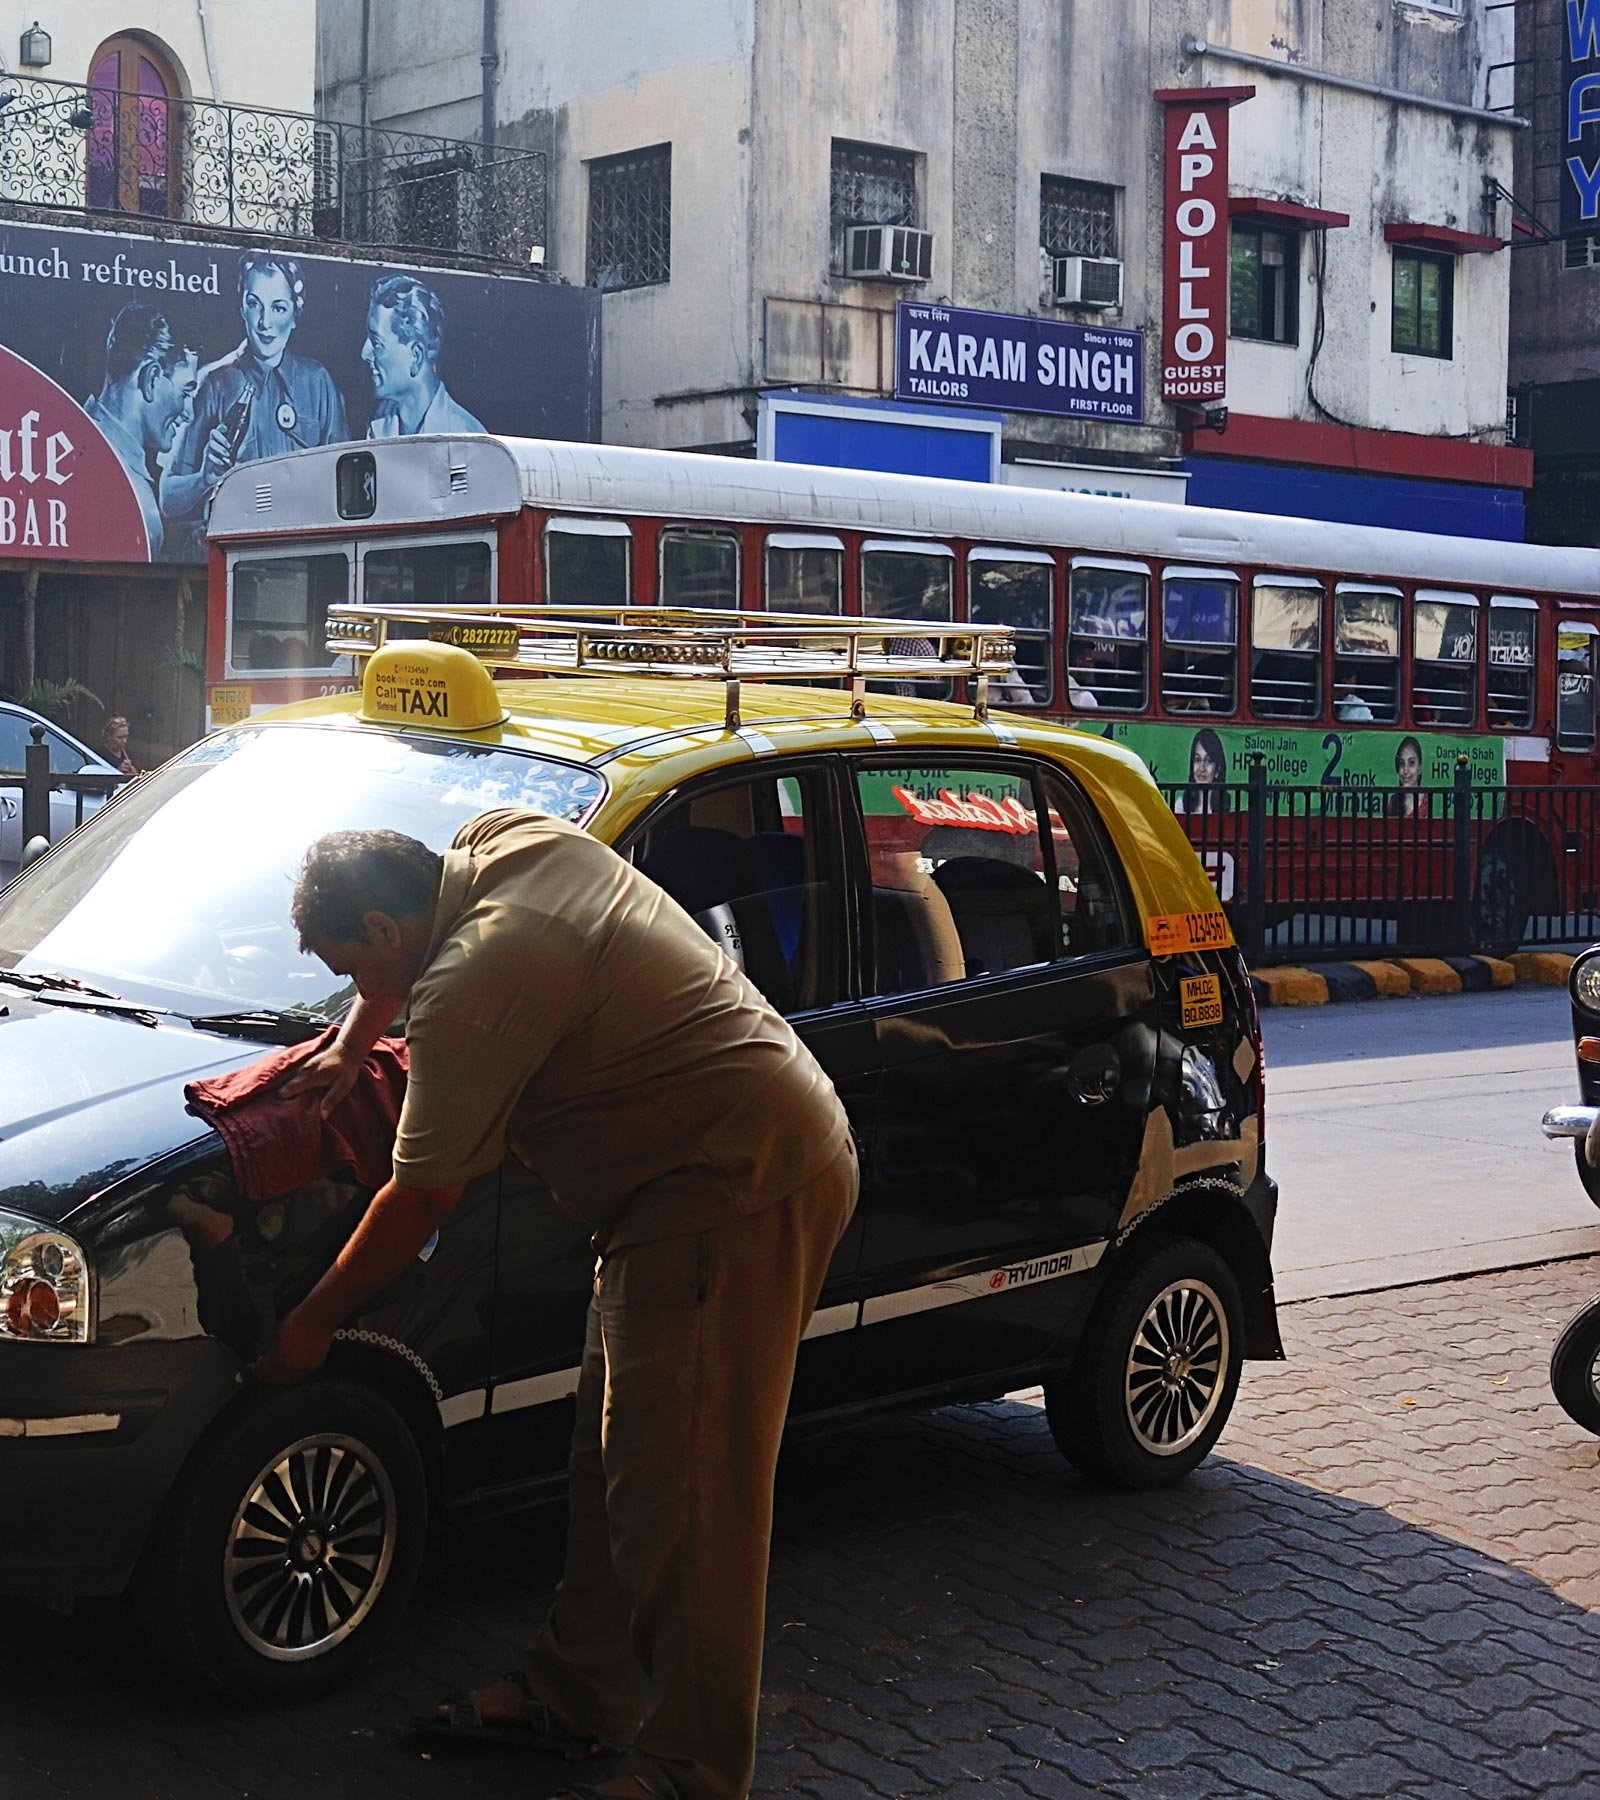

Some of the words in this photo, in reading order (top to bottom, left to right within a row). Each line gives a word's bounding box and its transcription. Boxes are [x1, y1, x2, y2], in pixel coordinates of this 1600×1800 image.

[1174, 112, 1217, 362] APOLLO
[81, 253, 221, 296] refreshed
[909, 309, 929, 320] करम
[1084, 332, 1107, 346] Since
[1114, 337, 1133, 348] 1960
[909, 328, 1026, 382] KARAM
[1037, 344, 1133, 395] SINGH
[1164, 365, 1224, 380] GUEST
[909, 378, 969, 399] TAILORS
[1164, 381, 1224, 395] HOUSE
[1070, 399, 1099, 412] FIRST
[1101, 402, 1133, 416] FLOOR
[462, 628, 518, 645] 28272727
[376, 685, 397, 700] Call
[397, 687, 449, 718] TAXI
[1245, 736, 1275, 750] Saloni
[1277, 737, 1298, 751] Jain
[1472, 748, 1494, 760] Shah
[1343, 768, 1377, 787] Rank
[1432, 762, 1449, 779] HR
[976, 784, 993, 800] To
[1187, 980, 1214, 997] MH.02
[1009, 1255, 1073, 1284] HYUNDAI
